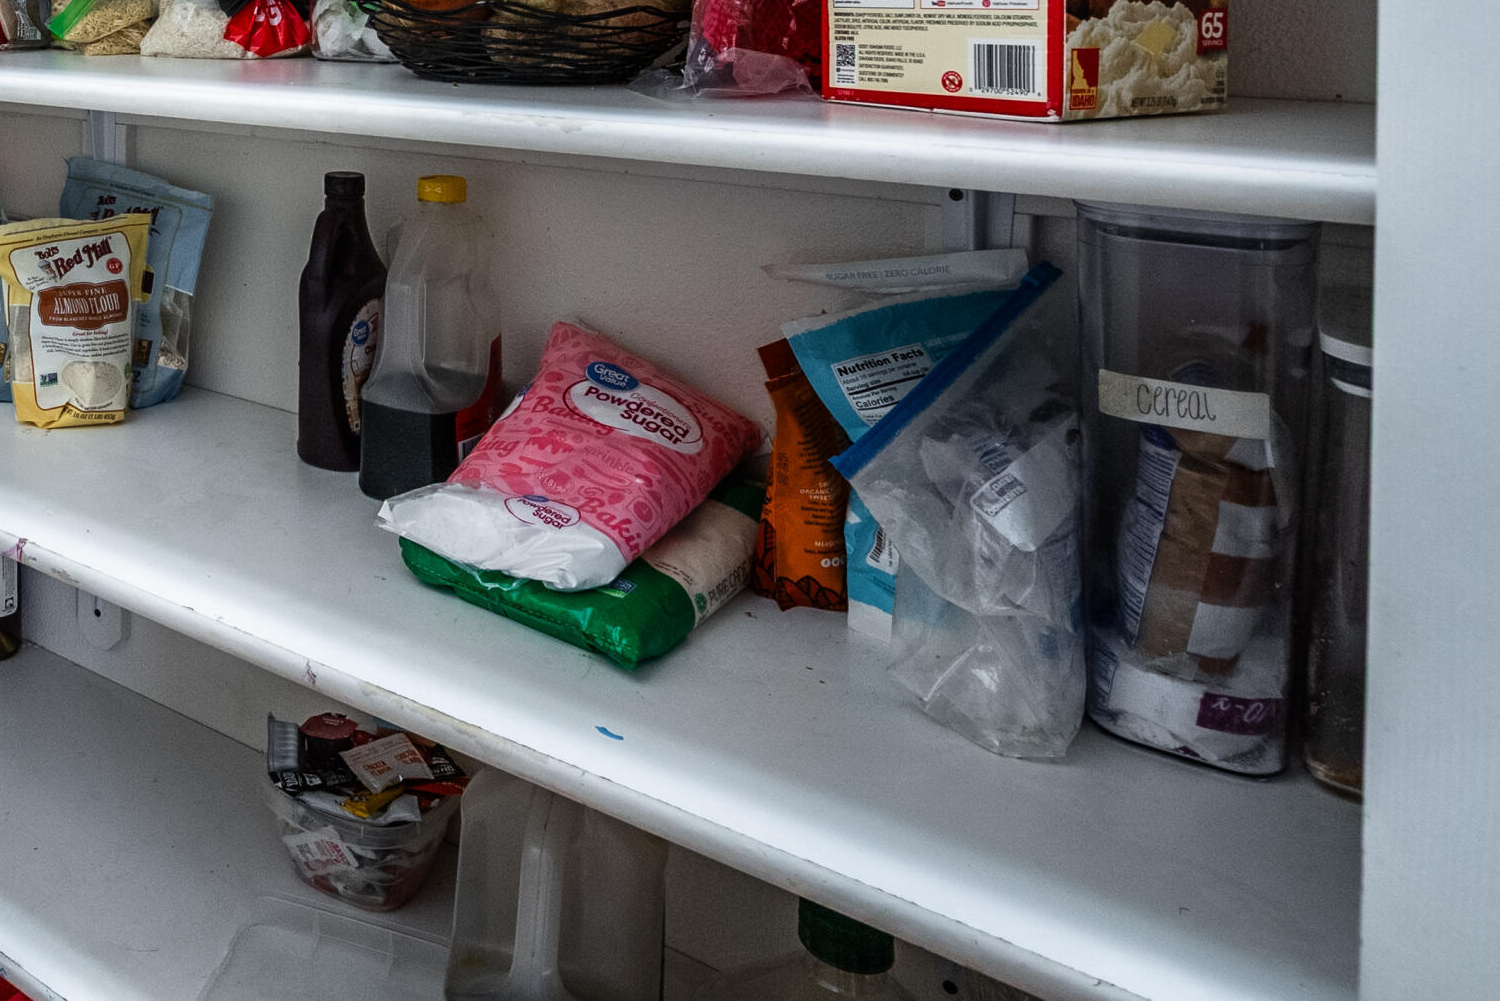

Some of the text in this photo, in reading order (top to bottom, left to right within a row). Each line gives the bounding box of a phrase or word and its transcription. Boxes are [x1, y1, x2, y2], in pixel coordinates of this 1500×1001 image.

[1201, 12, 1224, 39] 65
[35, 246, 59, 260] Bob's
[52, 237, 113, 280] Red Mill
[826, 265, 950, 280] SUGAR FREE ZERO CALORIE
[54, 293, 120, 315] ALMOND FLOUR
[594, 364, 630, 383] Great
[837, 348, 924, 377] Nutrition Facts
[599, 373, 627, 389] Value
[584, 385, 690, 439] Powdered
[856, 395, 895, 409] Calories
[1137, 383, 1216, 421] cereal
[620, 407, 682, 445] Sugar
[532, 509, 564, 530] Sugar
